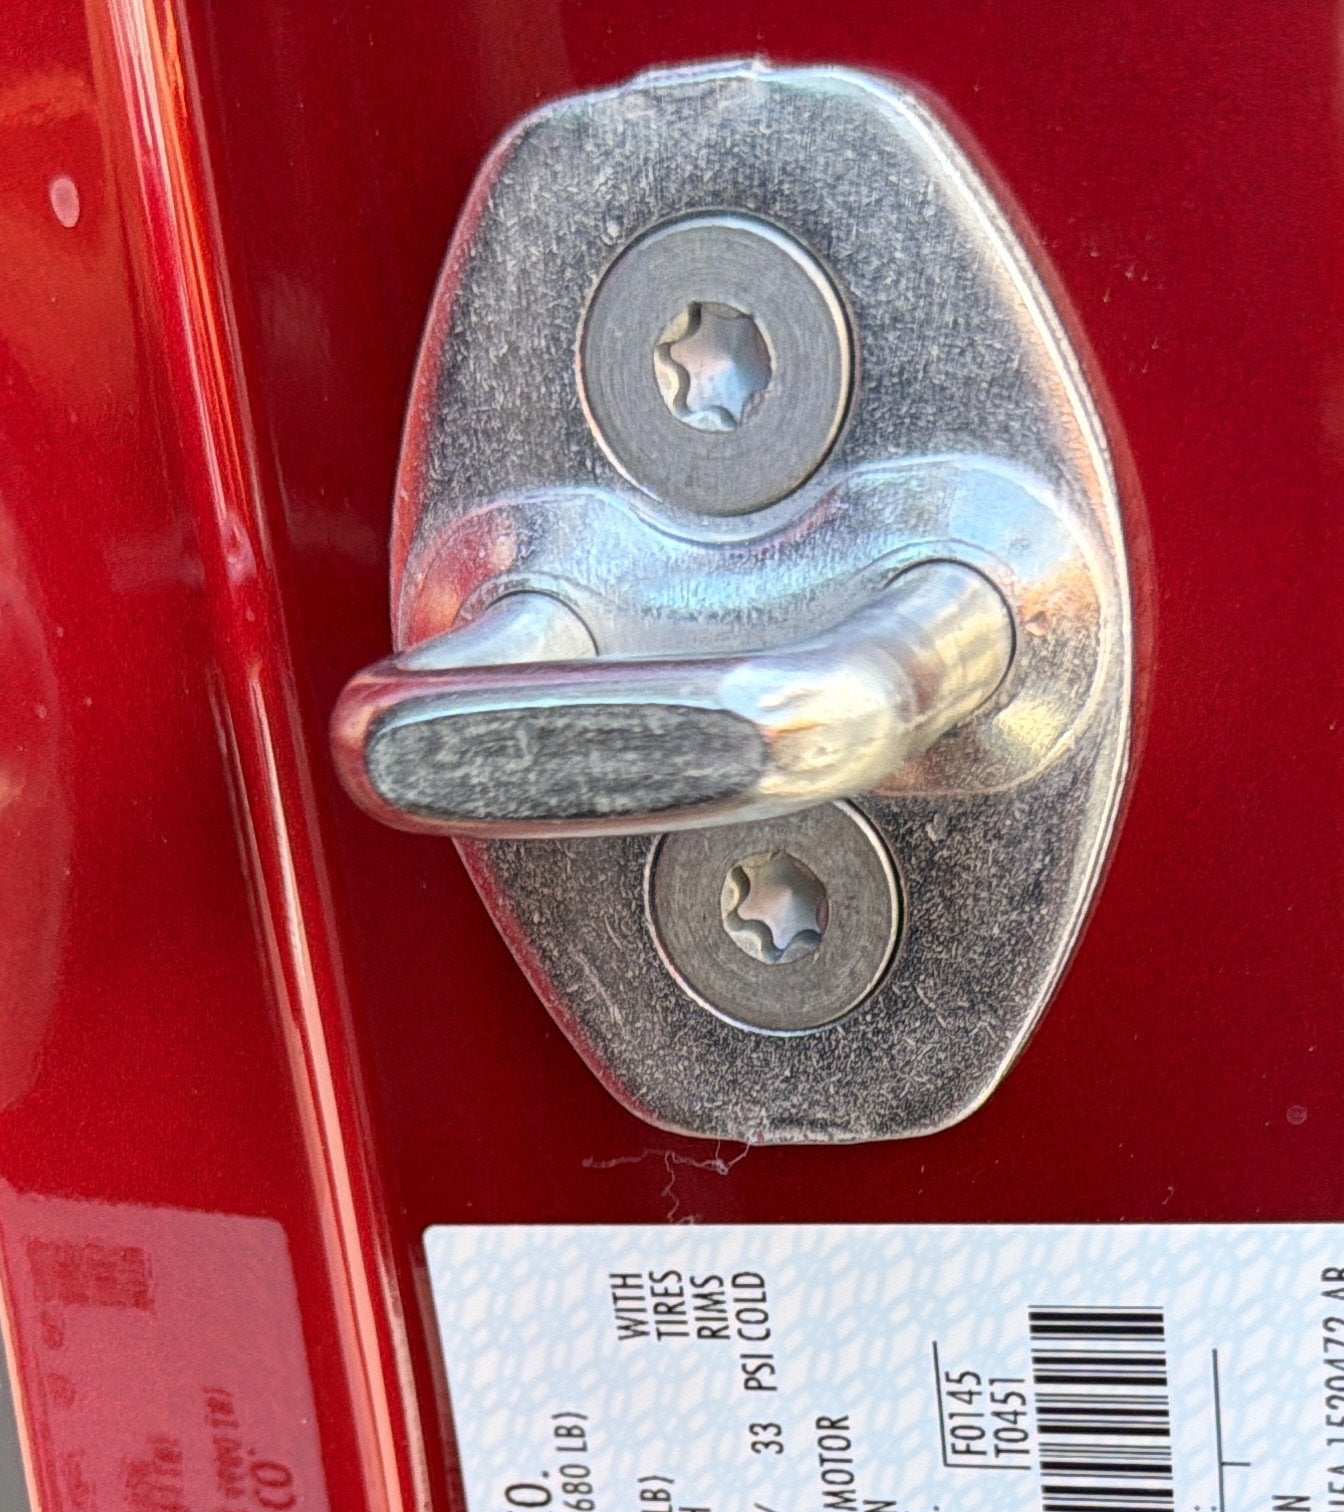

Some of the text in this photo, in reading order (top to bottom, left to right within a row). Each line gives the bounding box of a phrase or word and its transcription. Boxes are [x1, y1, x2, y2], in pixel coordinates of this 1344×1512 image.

[609, 1273, 650, 1340] WITH
[648, 1270, 691, 1341] TIRES
[690, 1275, 730, 1340] RIMS
[732, 1272, 771, 1341] COLD
[739, 1354, 777, 1392] PSI
[551, 1412, 589, 1453] LB)
[749, 1422, 783, 1455] 33
[945, 1370, 987, 1457] F0145
[990, 1377, 1029, 1458] T0451
[815, 1415, 856, 1512] MOTOR
